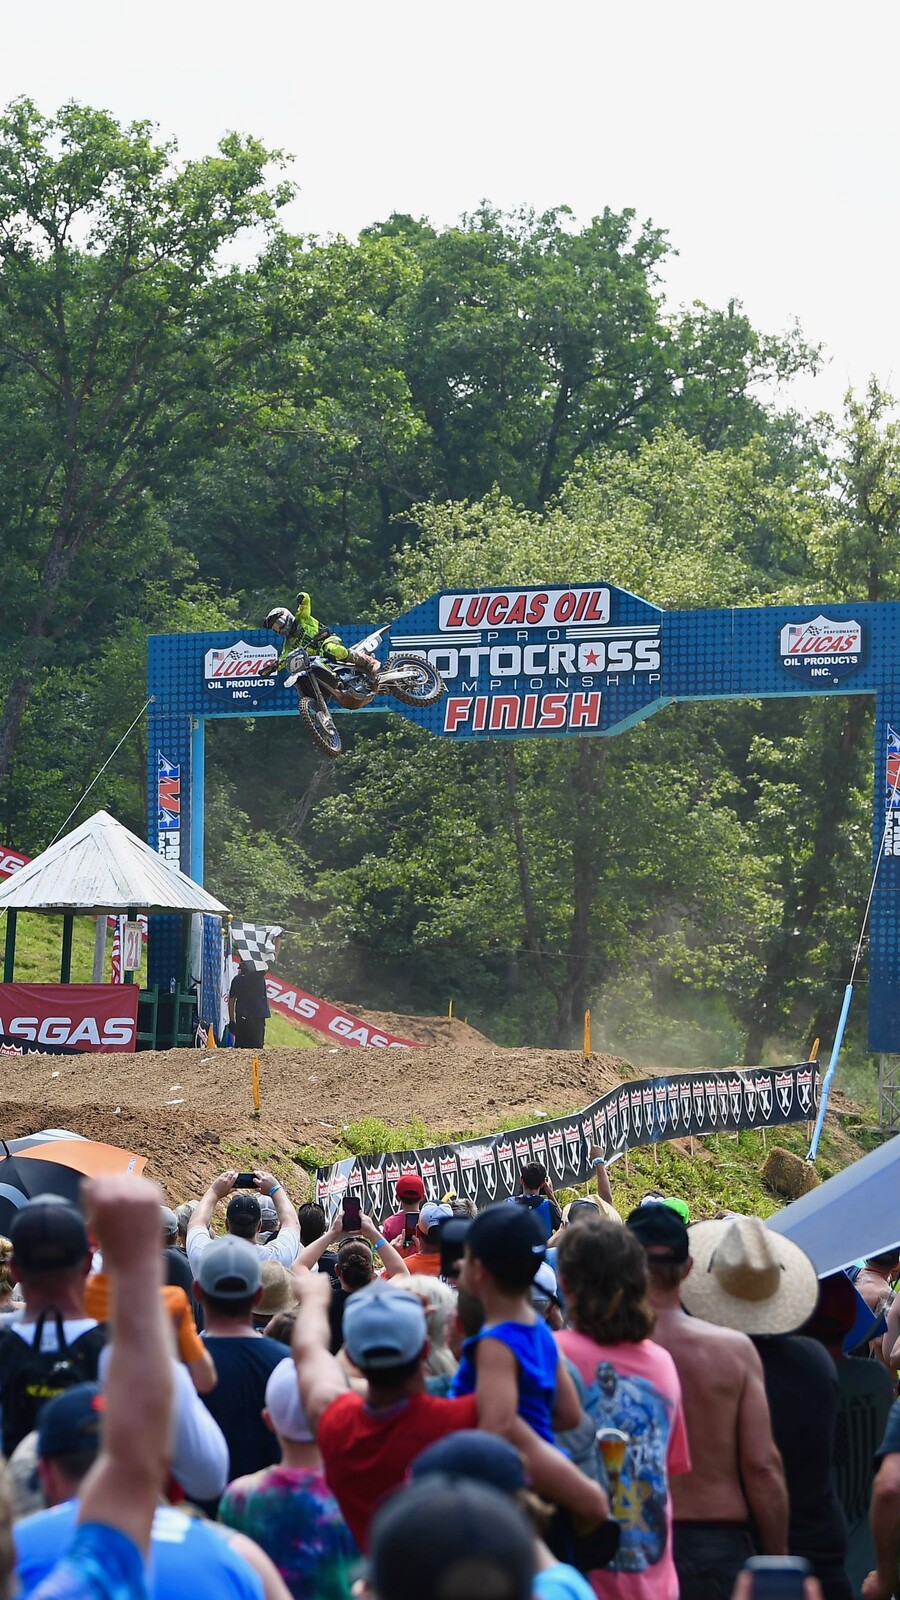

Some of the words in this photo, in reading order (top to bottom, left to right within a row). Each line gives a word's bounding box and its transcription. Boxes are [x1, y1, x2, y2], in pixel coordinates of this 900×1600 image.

[446, 592, 548, 627] LUCAS
[553, 591, 602, 623] OIL
[487, 629, 560, 643] PRO
[789, 635, 857, 653] LUCAS
[390, 639, 661, 679] OTOCROSS
[784, 658, 801, 666] OIL
[804, 656, 858, 665] PRODUCTS
[811, 668, 831, 677] INC.
[207, 681, 224, 689] OIL
[226, 679, 275, 689] PRODUCTS
[442, 674, 661, 692] MPIONSHIP
[233, 690, 251, 699] INC.
[444, 692, 602, 732] FINISH
[0, 1017, 135, 1045] SGAS
[328, 1016, 409, 1048] GAS
